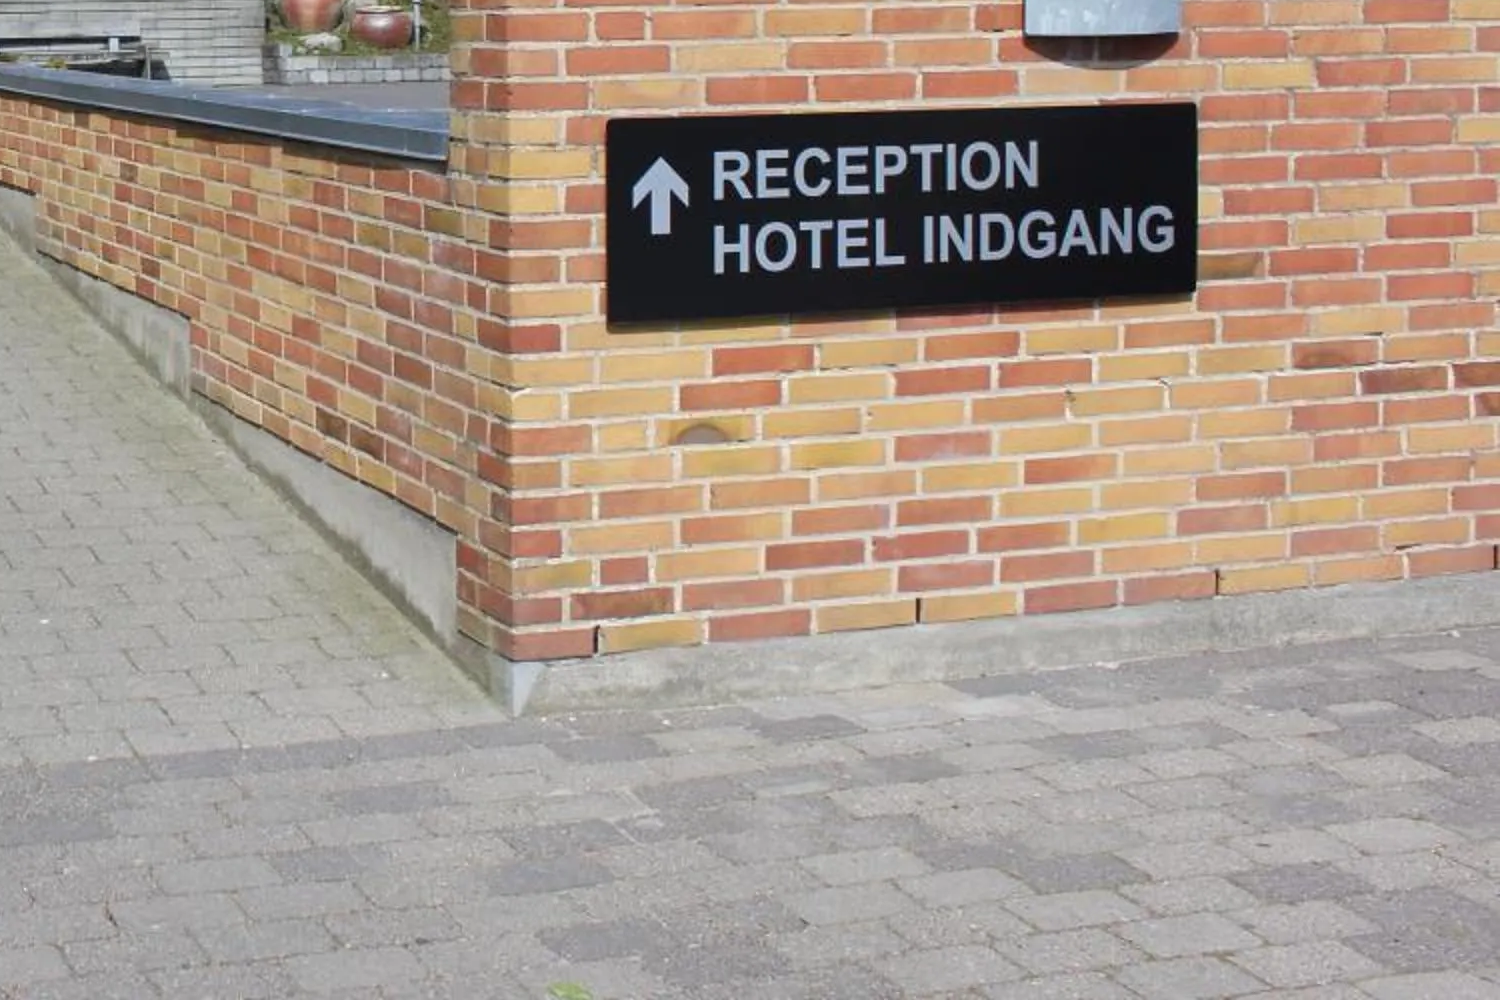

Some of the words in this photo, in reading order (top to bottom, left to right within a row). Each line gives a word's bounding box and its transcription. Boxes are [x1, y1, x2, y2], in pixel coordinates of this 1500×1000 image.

[713, 140, 1039, 201] RECEPTION
[713, 218, 906, 274] HOTEL
[923, 205, 1175, 264] INDGANG
